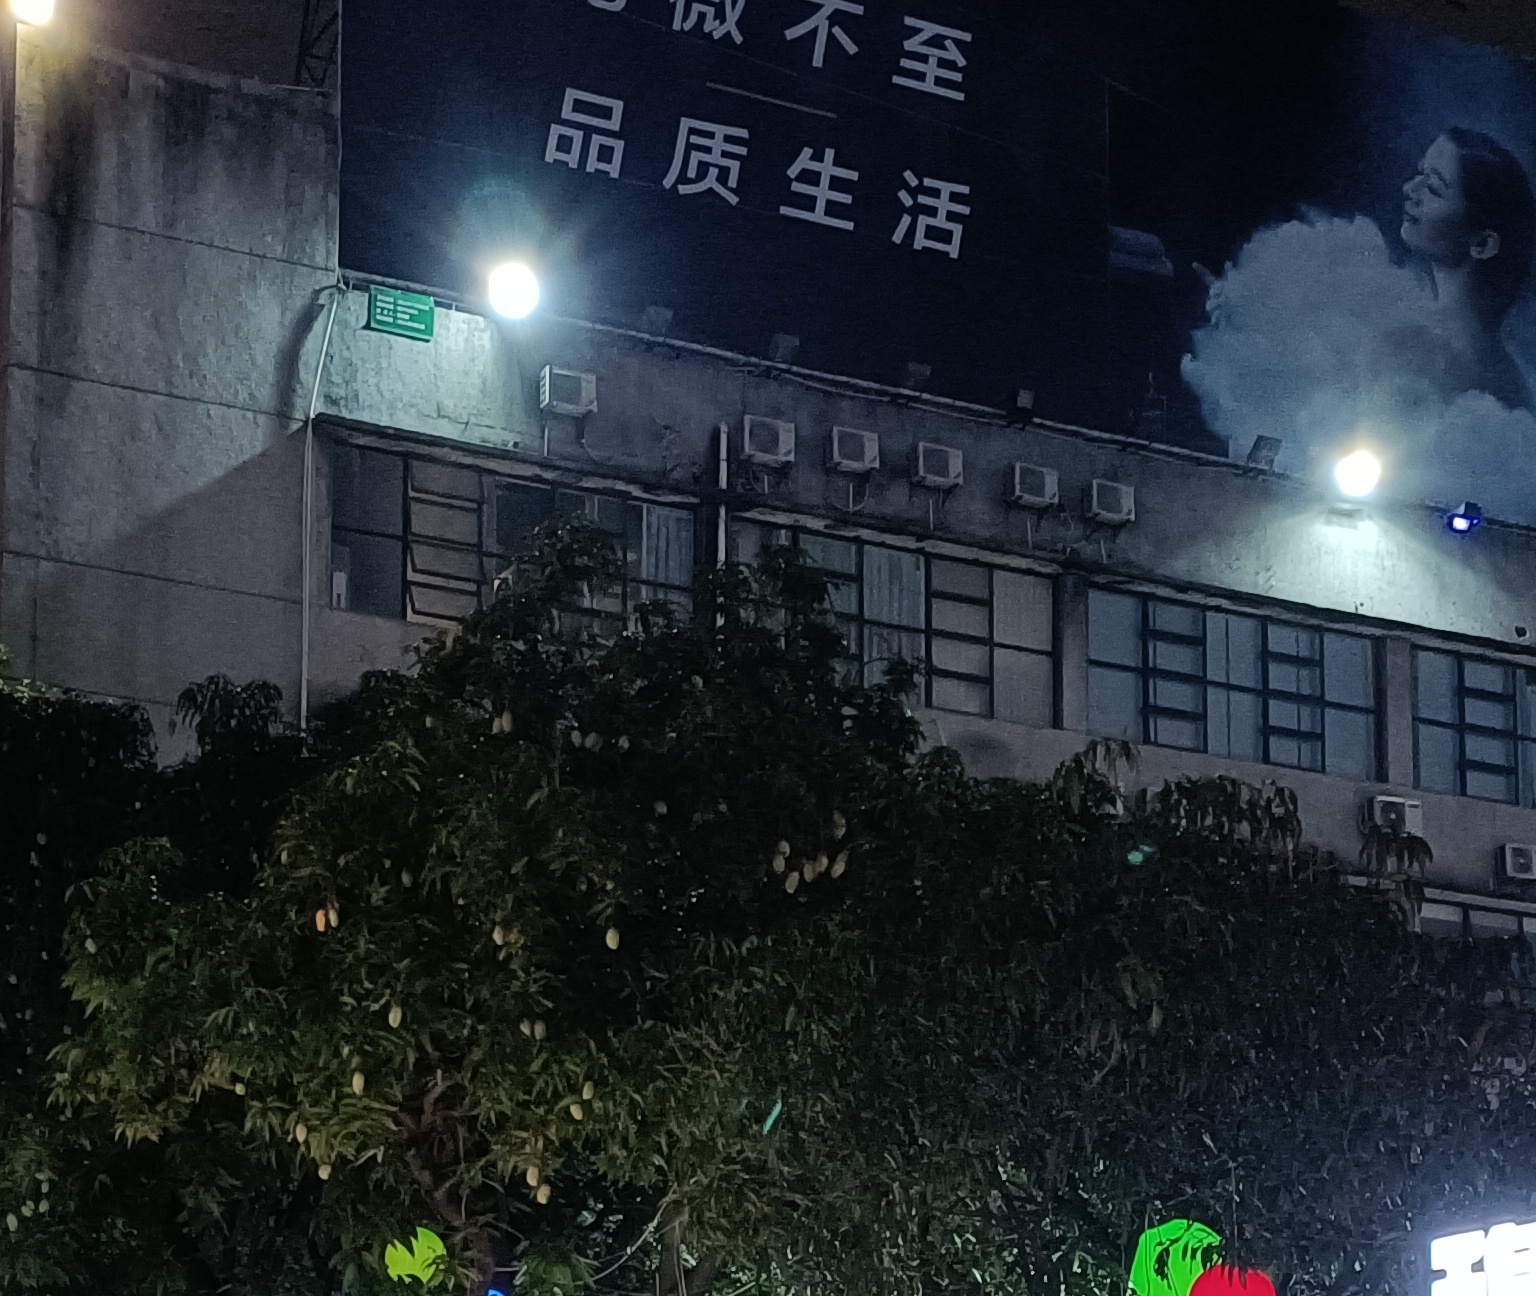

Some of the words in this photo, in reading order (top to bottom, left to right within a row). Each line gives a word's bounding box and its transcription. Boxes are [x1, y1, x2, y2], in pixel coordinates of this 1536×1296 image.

[586, 0, 972, 101] 微不至
[544, 88, 972, 259] 品质生活
